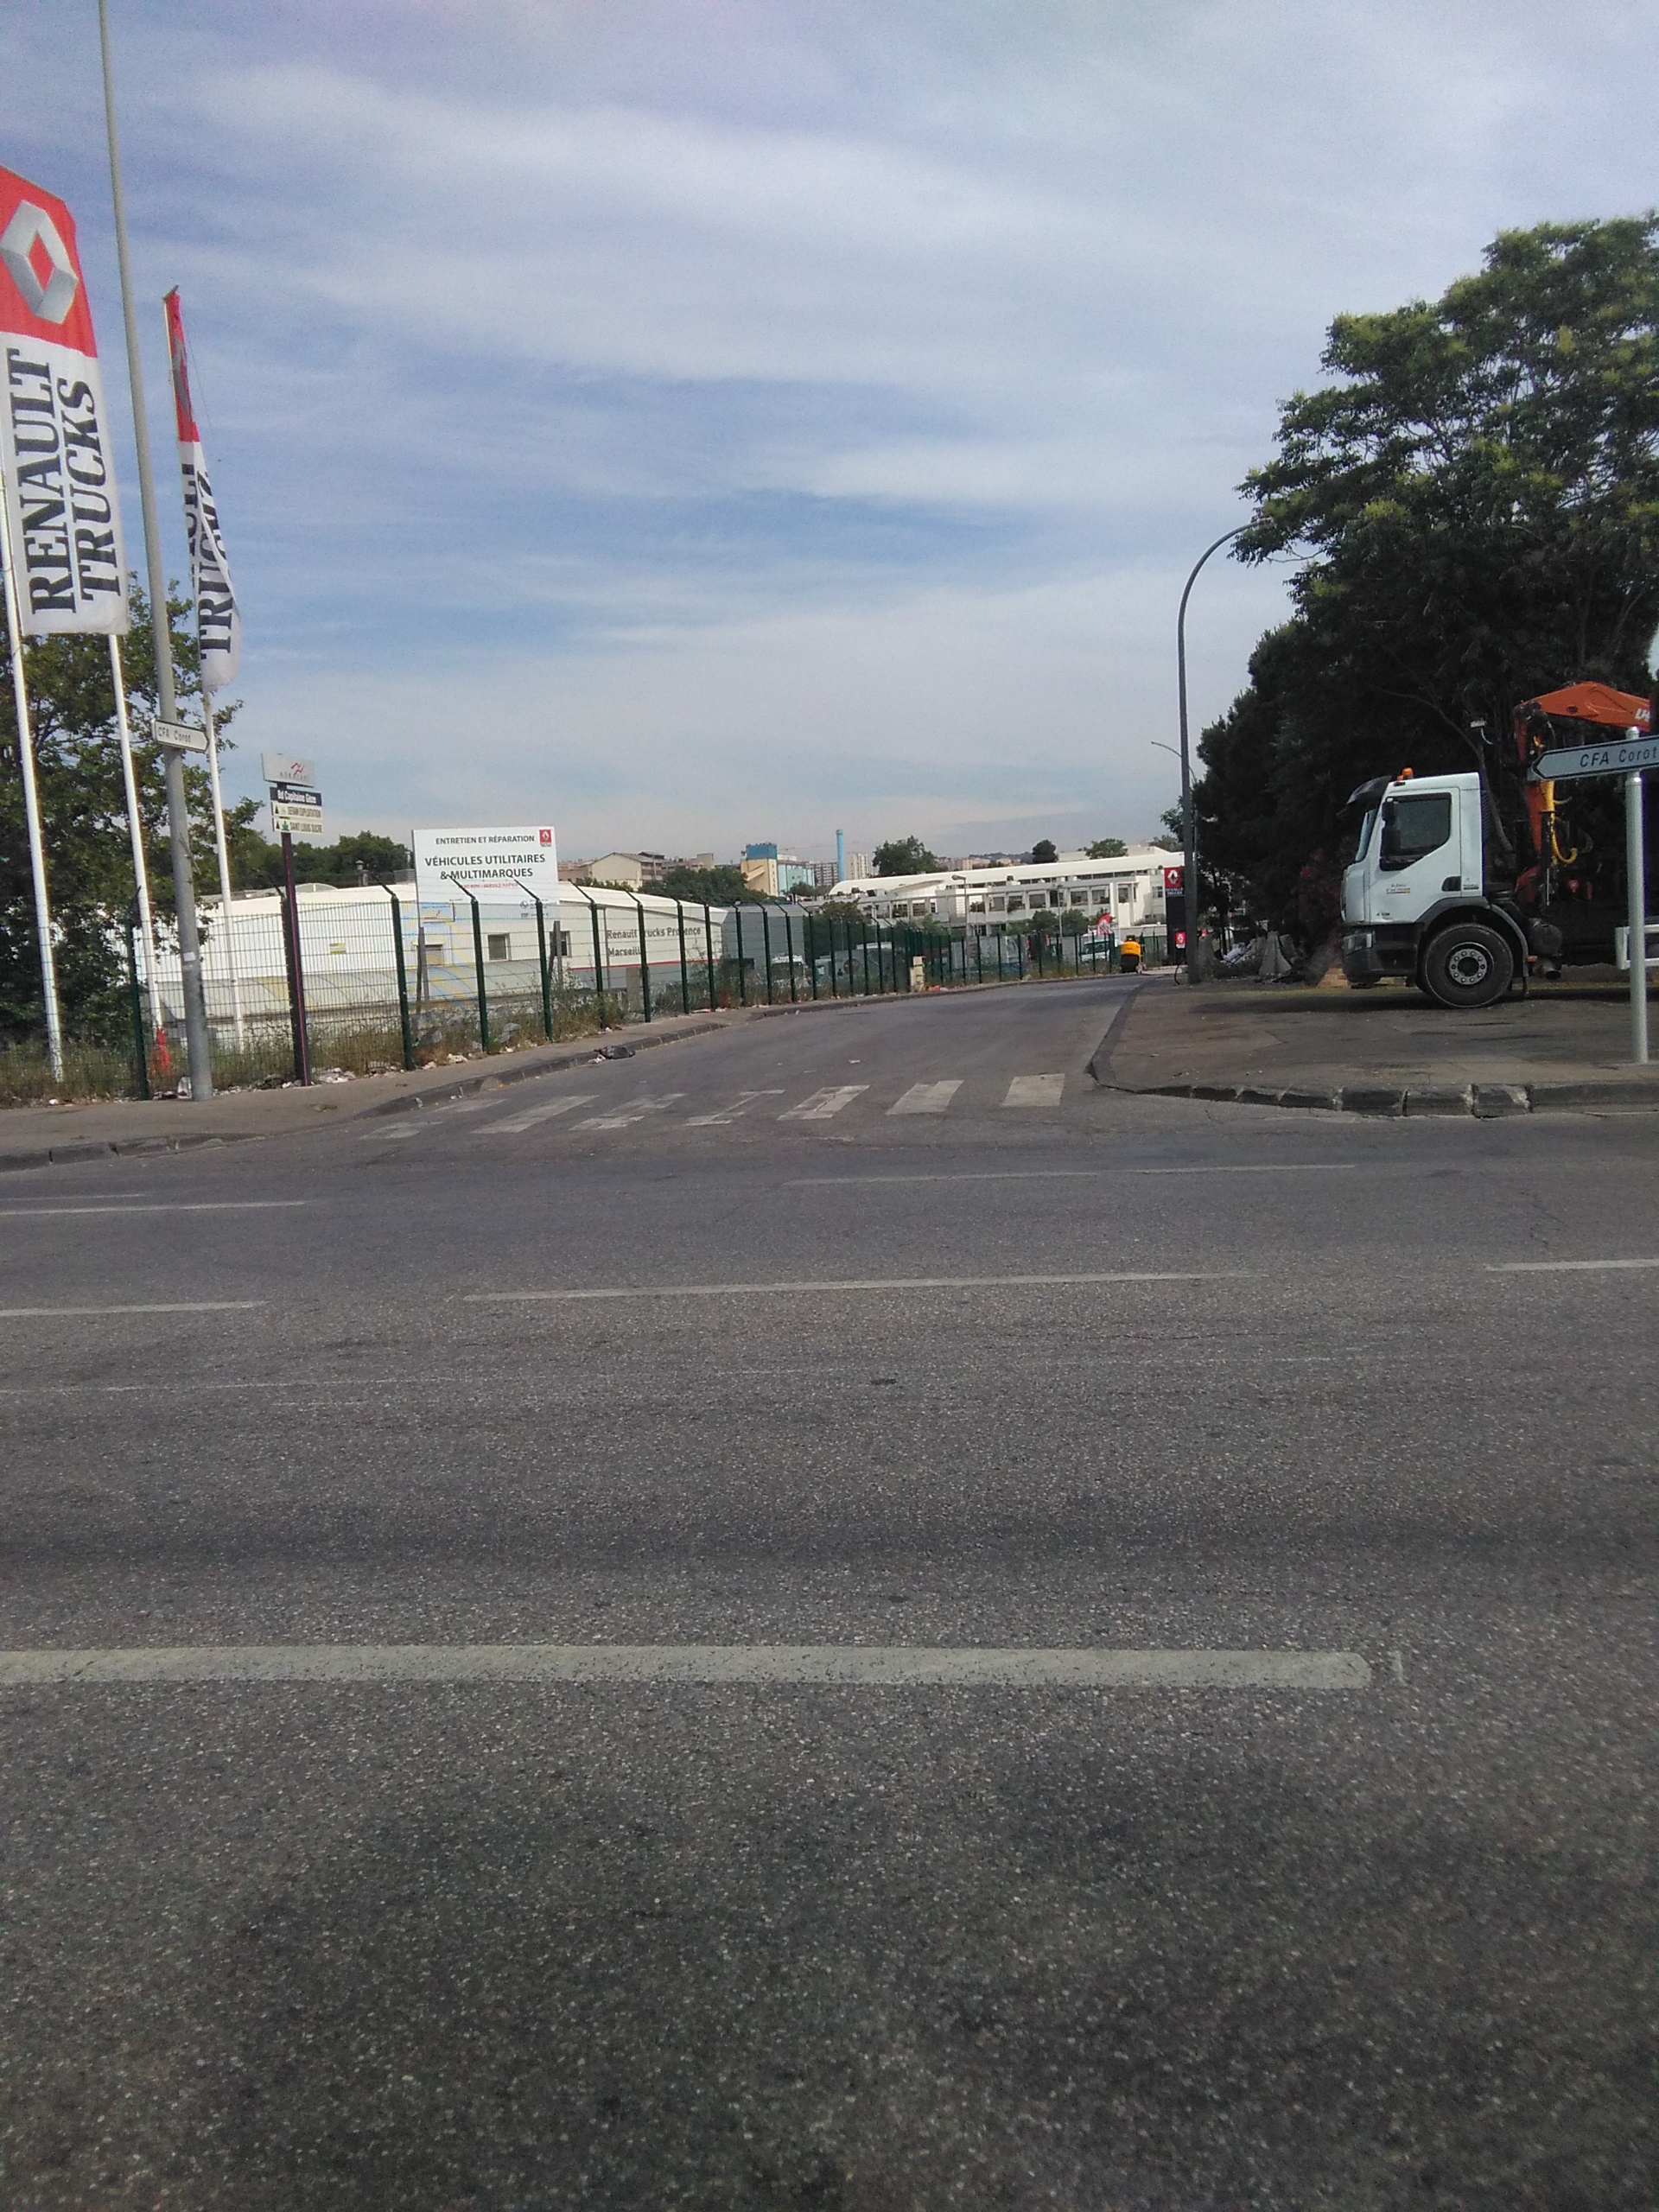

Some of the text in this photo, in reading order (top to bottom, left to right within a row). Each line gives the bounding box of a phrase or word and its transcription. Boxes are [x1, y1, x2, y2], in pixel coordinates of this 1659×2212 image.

[7, 347, 76, 614] RENAULT
[56, 377, 121, 601] TRUCKS
[158, 726, 169, 738] CFA
[1580, 747, 1658, 767] CFA Corot
[435, 836, 477, 845] ENTRETIEN
[488, 835, 535, 844] RÉPARATION
[424, 854, 546, 867] VÉHICULES UTILITAIRES
[449, 868, 533, 880] MULTIMARQUES
[606, 926, 701, 939] Renault rucks Proence
[607, 946, 642, 957] Marseill
